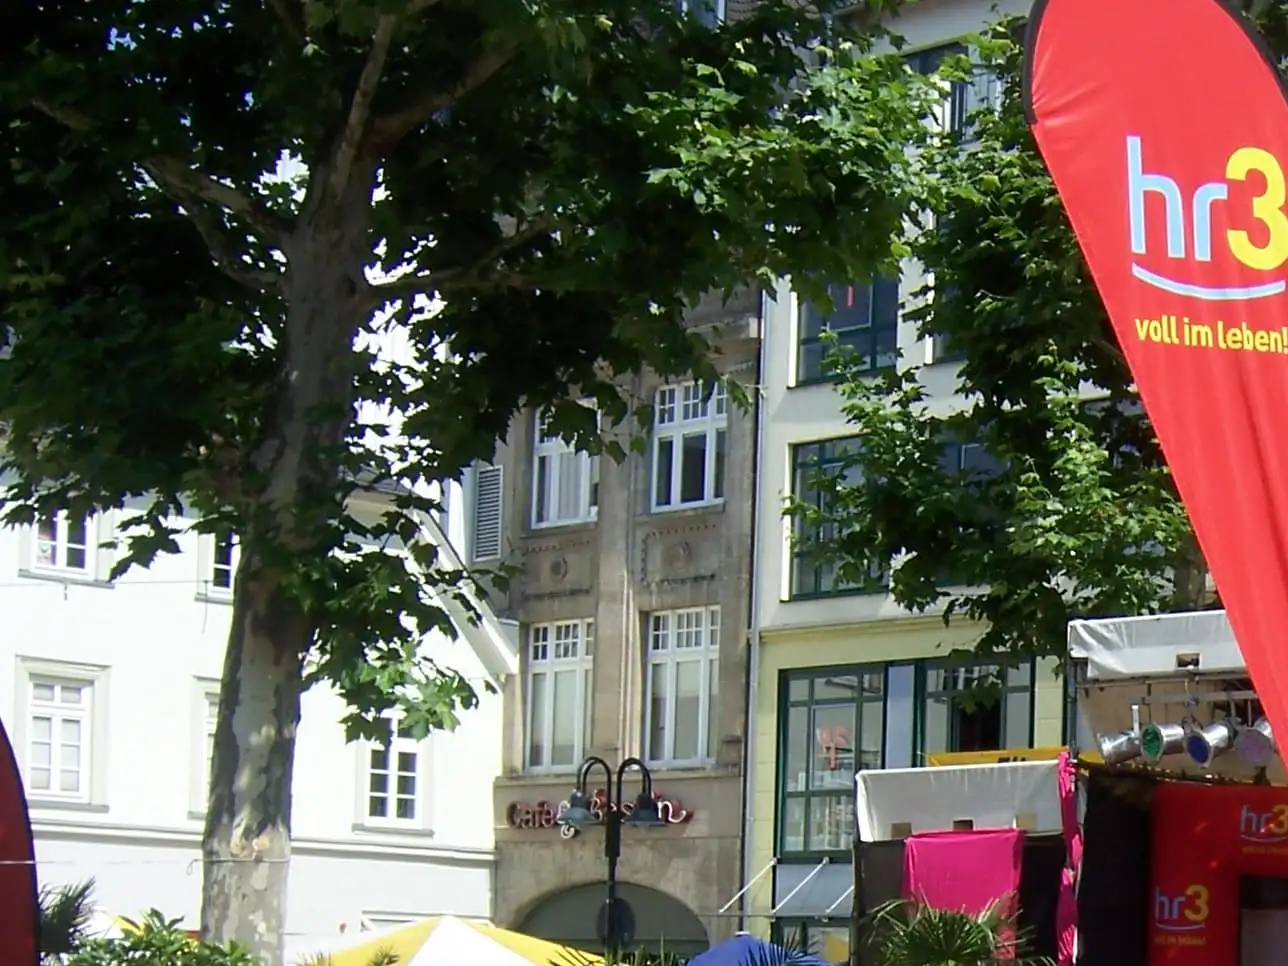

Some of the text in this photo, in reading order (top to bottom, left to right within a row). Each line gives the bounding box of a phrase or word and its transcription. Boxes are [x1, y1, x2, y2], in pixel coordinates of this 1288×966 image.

[1135, 315, 1288, 354] voll im leben!
[1155, 885, 1209, 921] hr3
